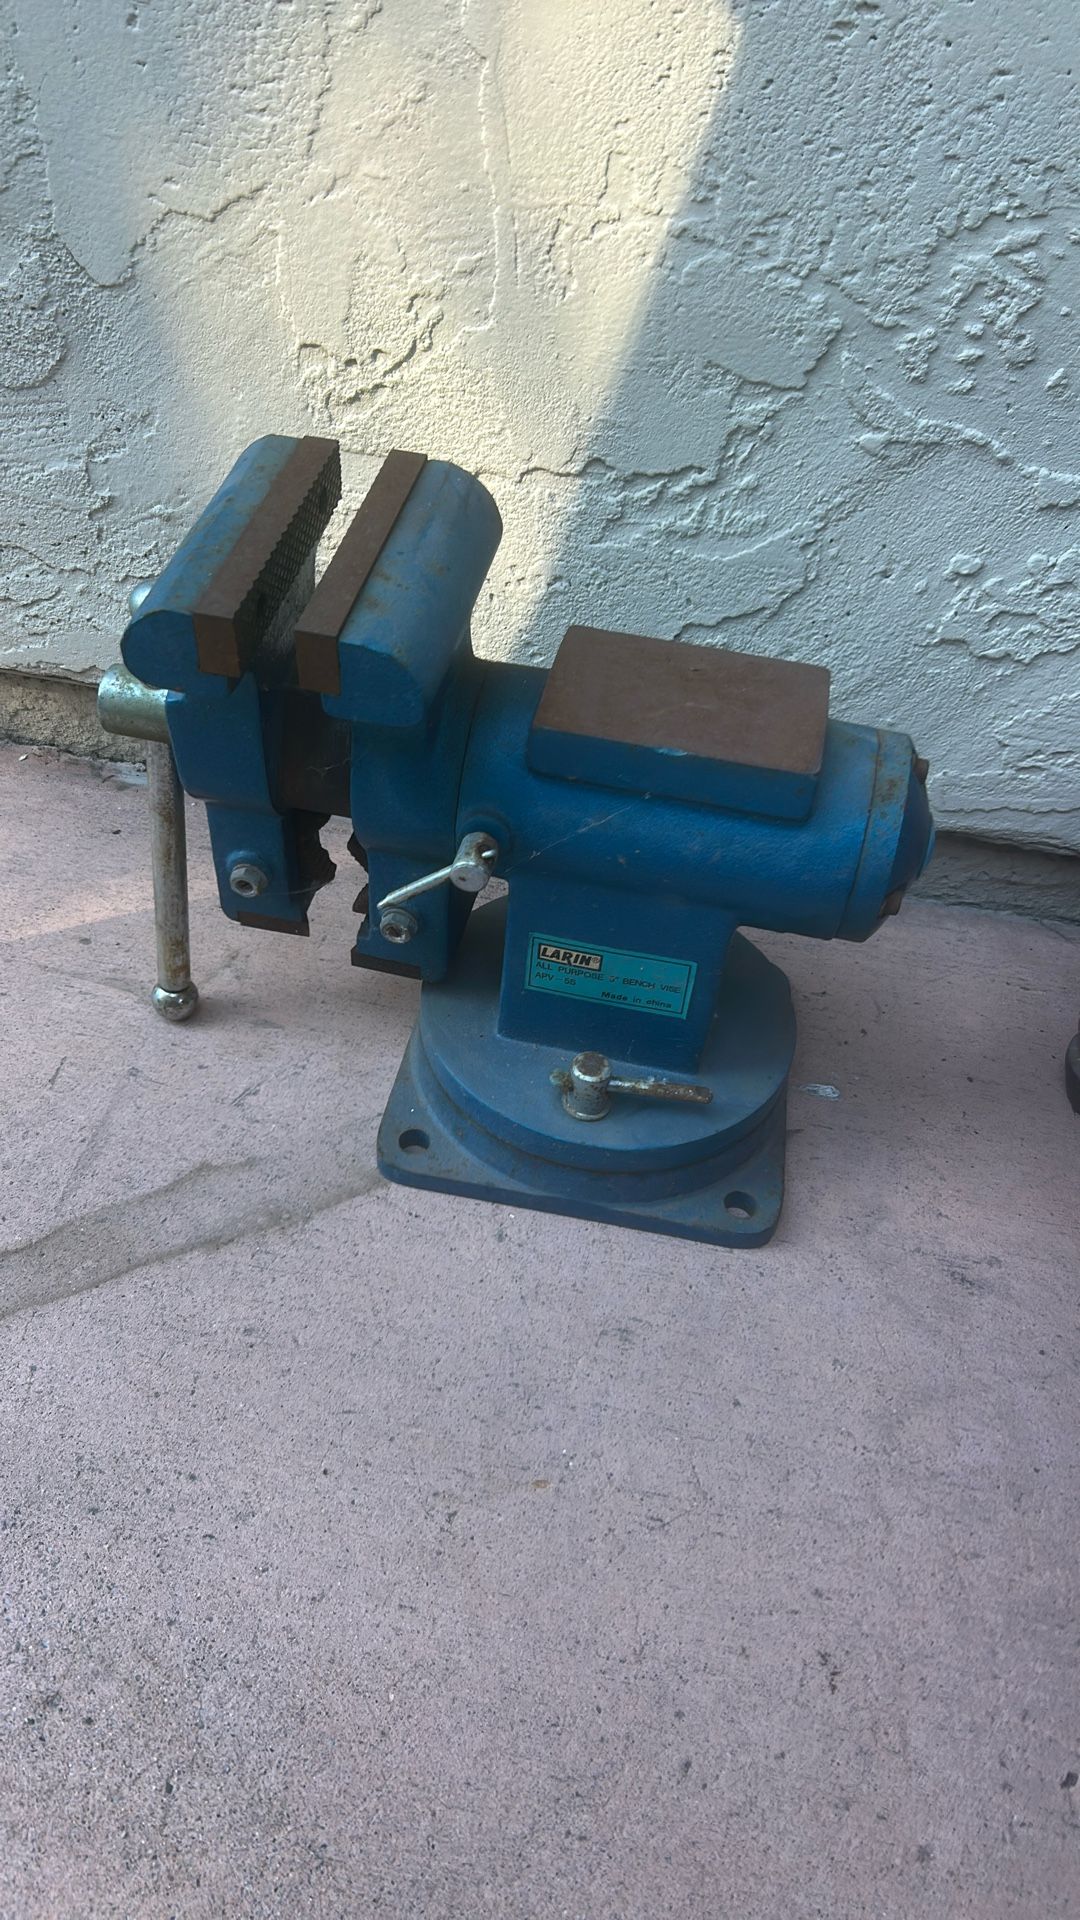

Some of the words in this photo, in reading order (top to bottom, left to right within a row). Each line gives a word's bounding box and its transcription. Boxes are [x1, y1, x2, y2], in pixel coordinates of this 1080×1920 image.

[535, 971, 554, 981] APV
[536, 961, 553, 971] ALL
[558, 965, 604, 981] PURPOSE
[622, 978, 656, 989] BENCH
[660, 984, 682, 994] VISE
[601, 991, 629, 1002] Made
[632, 995, 642, 1004] in
